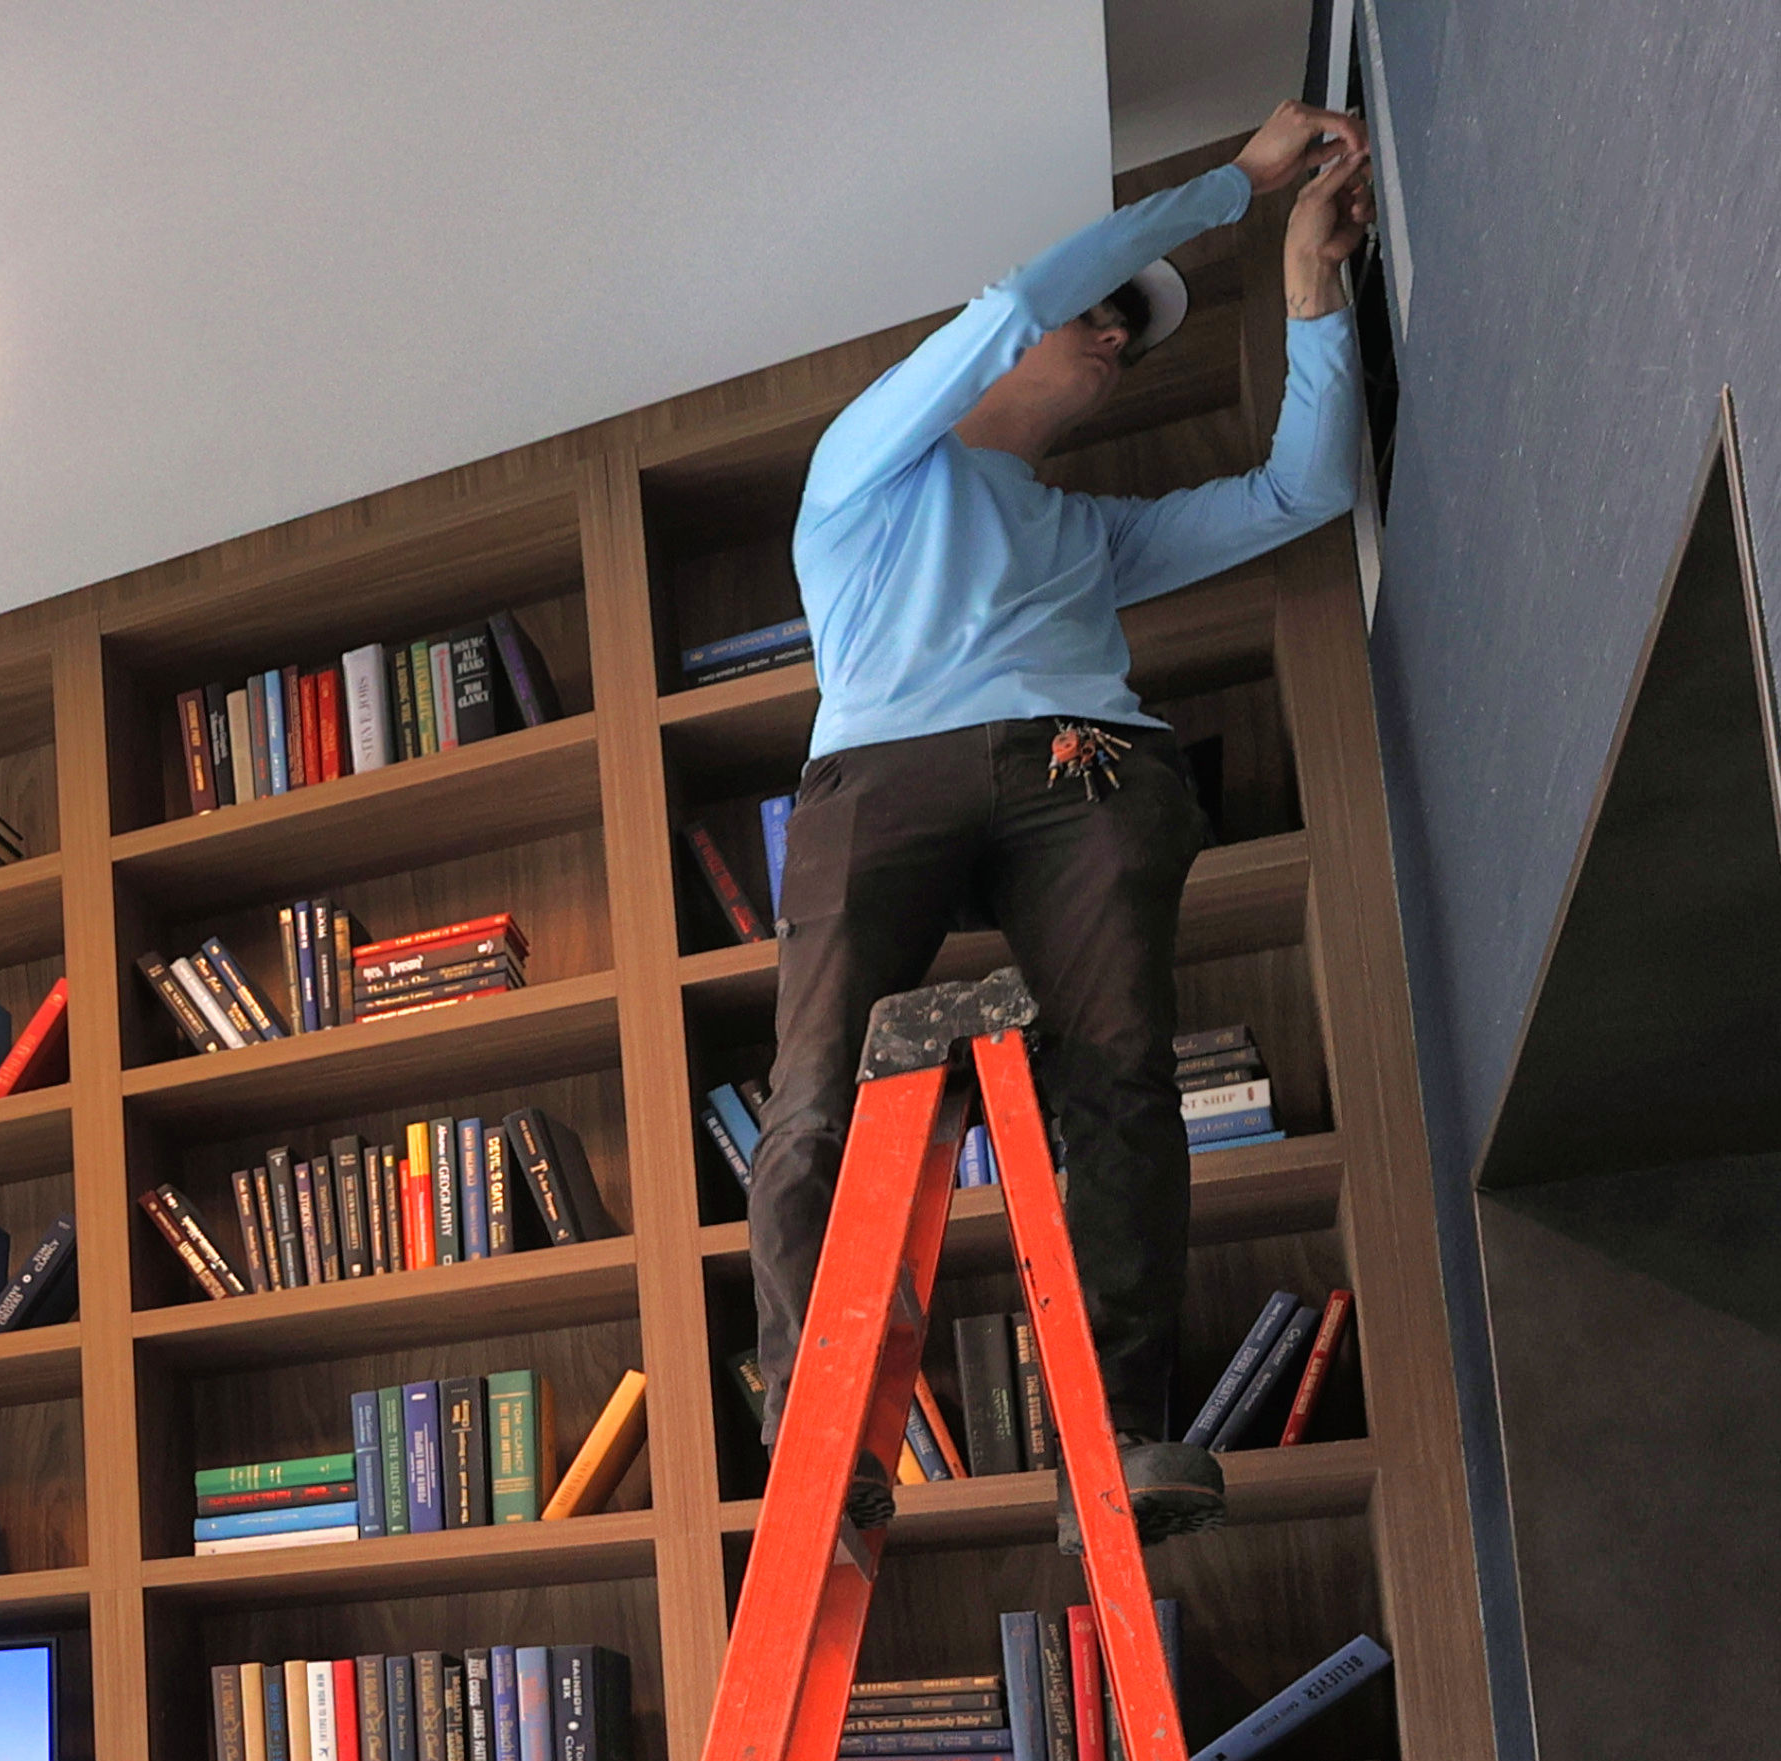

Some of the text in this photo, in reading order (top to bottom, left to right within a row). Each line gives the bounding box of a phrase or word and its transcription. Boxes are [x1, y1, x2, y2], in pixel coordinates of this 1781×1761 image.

[514, 1402, 523, 1471] TOM CLANCY
[389, 1437, 401, 1517] THE SILENT SEA
